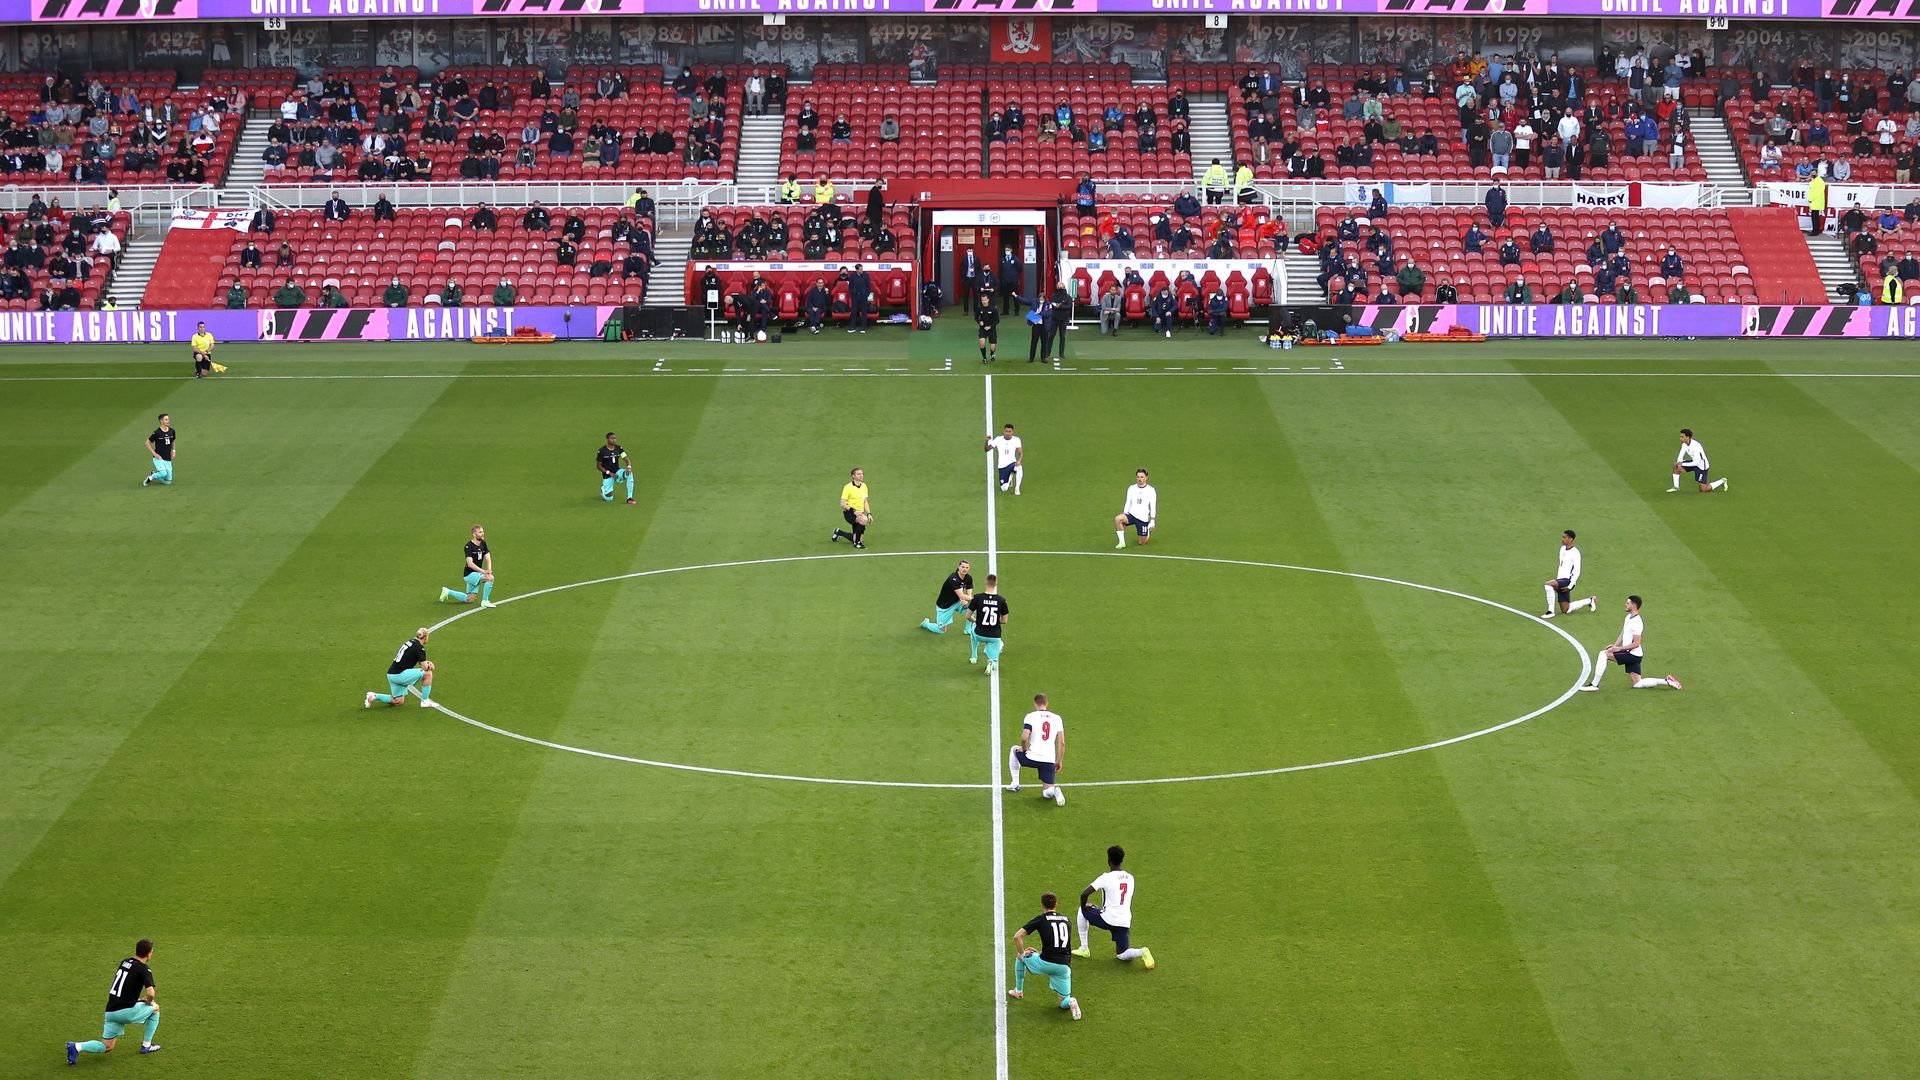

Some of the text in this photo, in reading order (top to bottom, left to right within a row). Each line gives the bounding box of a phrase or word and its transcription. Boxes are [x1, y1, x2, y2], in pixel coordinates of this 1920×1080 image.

[771, 13, 777, 23] 7
[1213, 16, 1219, 26] 8
[268, 30, 316, 45] 1949
[512, 27, 559, 43] 1974
[634, 26, 682, 42] 1986
[757, 25, 805, 41] 1988
[1086, 25, 1135, 41] 1995
[1253, 26, 1299, 41] 1997
[1374, 26, 1421, 42] 1998
[1494, 27, 1543, 42] 1999
[1614, 28, 1662, 43] 2003
[1735, 30, 1783, 45] 2004
[1854, 32, 1901, 47] 2005
[1577, 193, 1625, 206] HARRY
[1847, 193, 1858, 201] OF
[0, 311, 178, 341] UNITE AGAINST
[407, 308, 515, 339] AGAINST
[1479, 305, 1537, 335] UNITE
[1553, 305, 1662, 335] AGAINST
[1887, 306, 1916, 336] AG
[981, 606, 999, 626] 25
[1041, 721, 1051, 741] 9
[1119, 882, 1128, 905] 7
[1050, 921, 1070, 948] 19
[109, 968, 129, 998] 21
